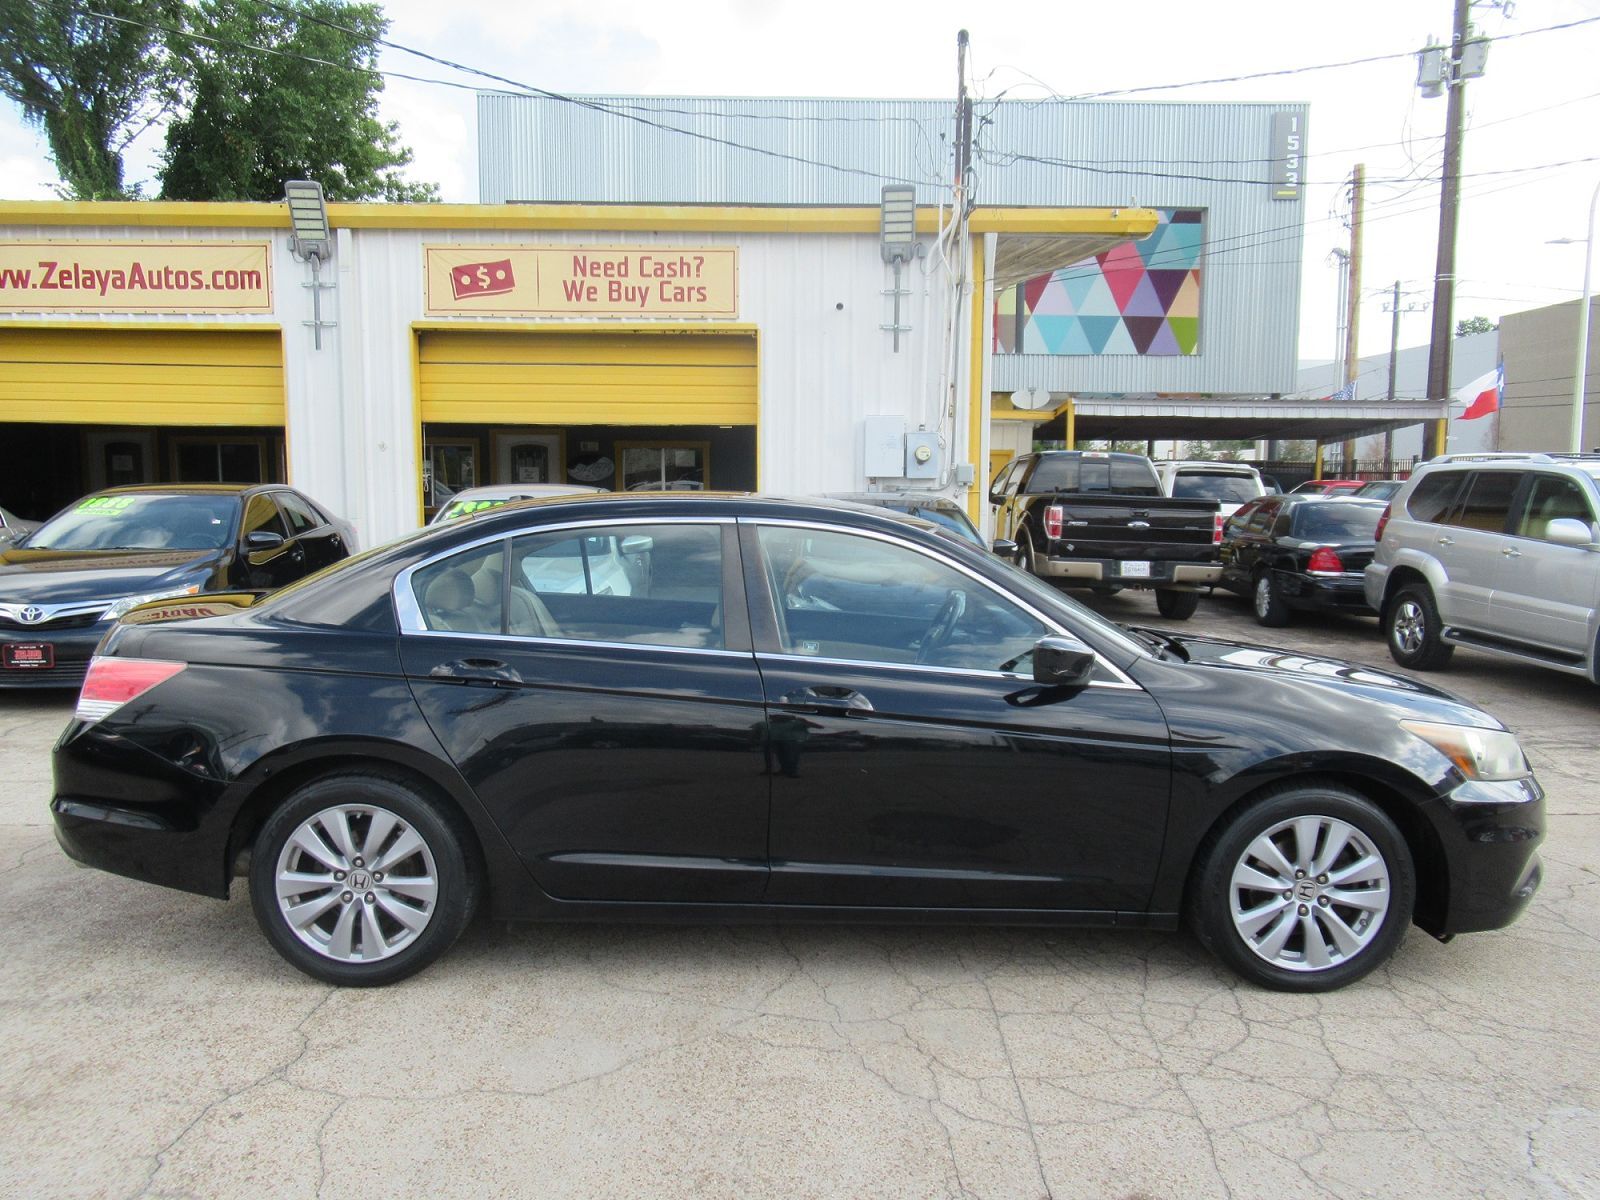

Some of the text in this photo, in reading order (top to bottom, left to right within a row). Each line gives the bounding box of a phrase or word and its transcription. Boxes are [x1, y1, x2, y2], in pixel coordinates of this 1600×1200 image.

[573, 255, 705, 278] Need Cash?
[562, 280, 707, 307] We Buy Cars
